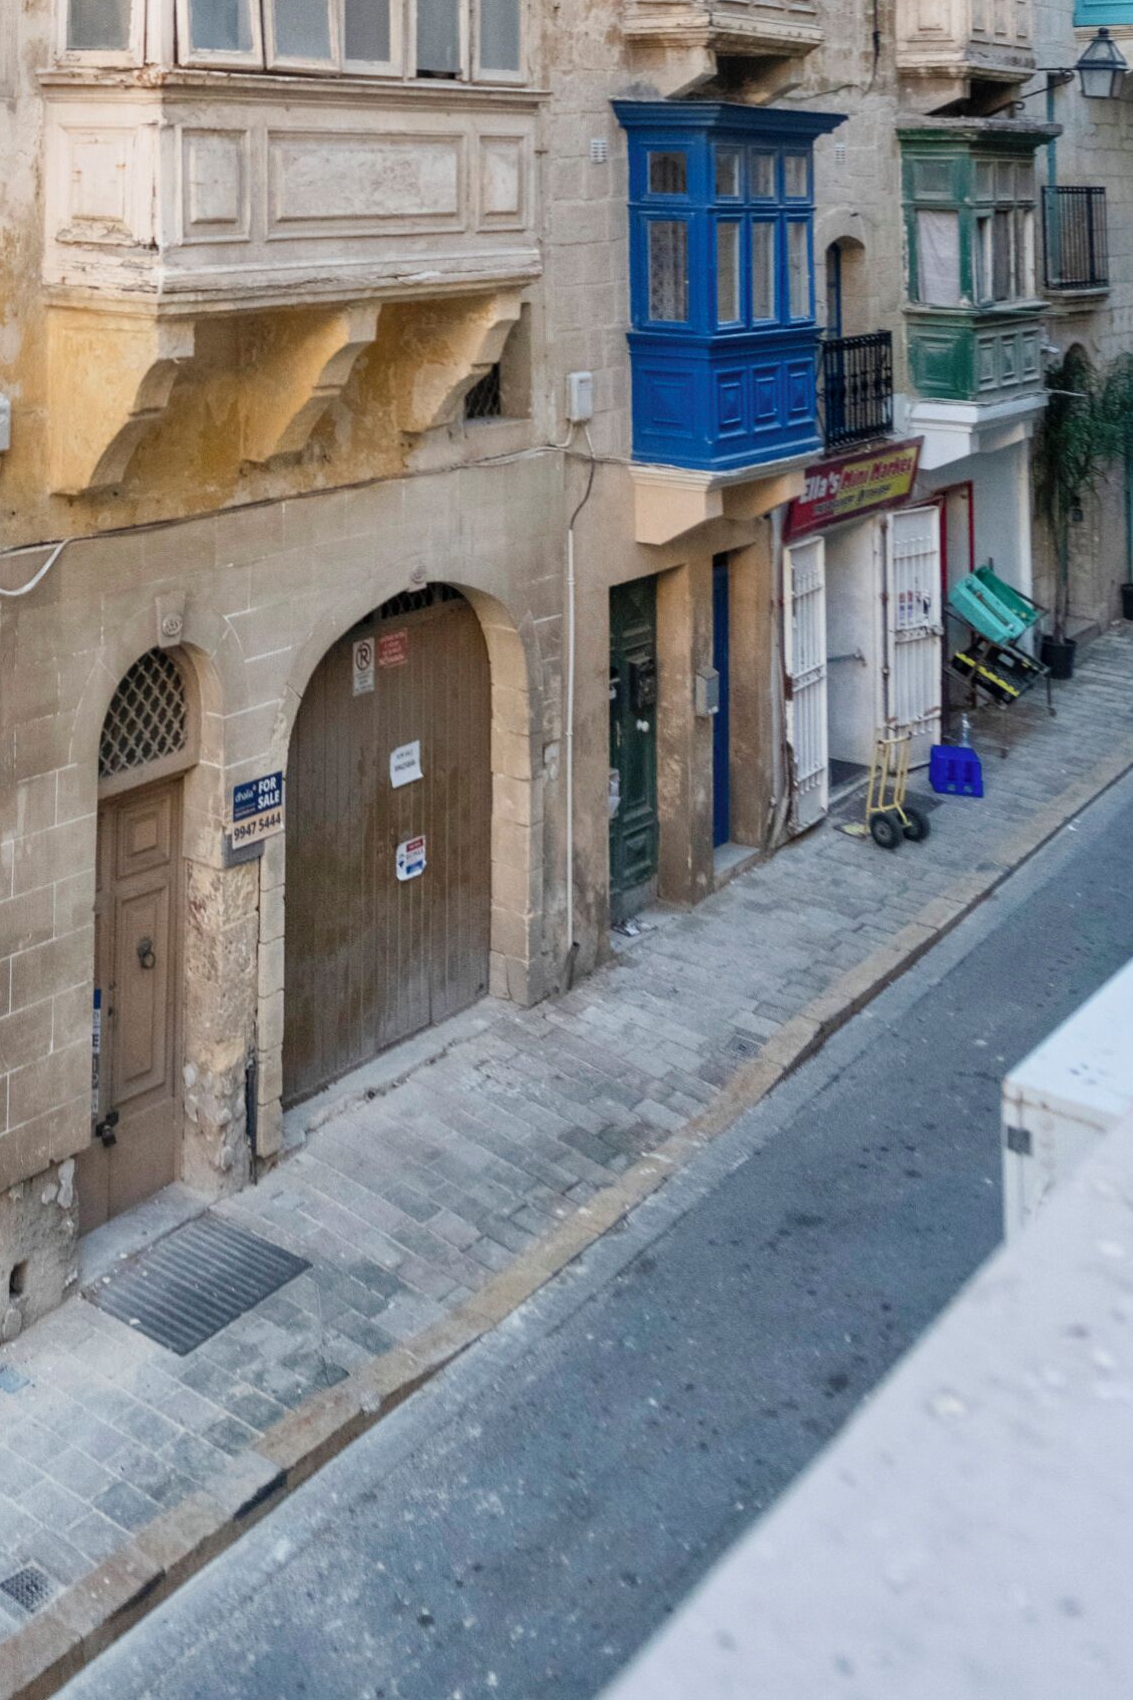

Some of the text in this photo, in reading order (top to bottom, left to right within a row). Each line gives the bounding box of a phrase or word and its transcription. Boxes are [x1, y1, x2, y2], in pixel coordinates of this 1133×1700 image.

[258, 776, 277, 794] FOR
[257, 790, 280, 810] SALE
[234, 812, 281, 841] 9947 5444
